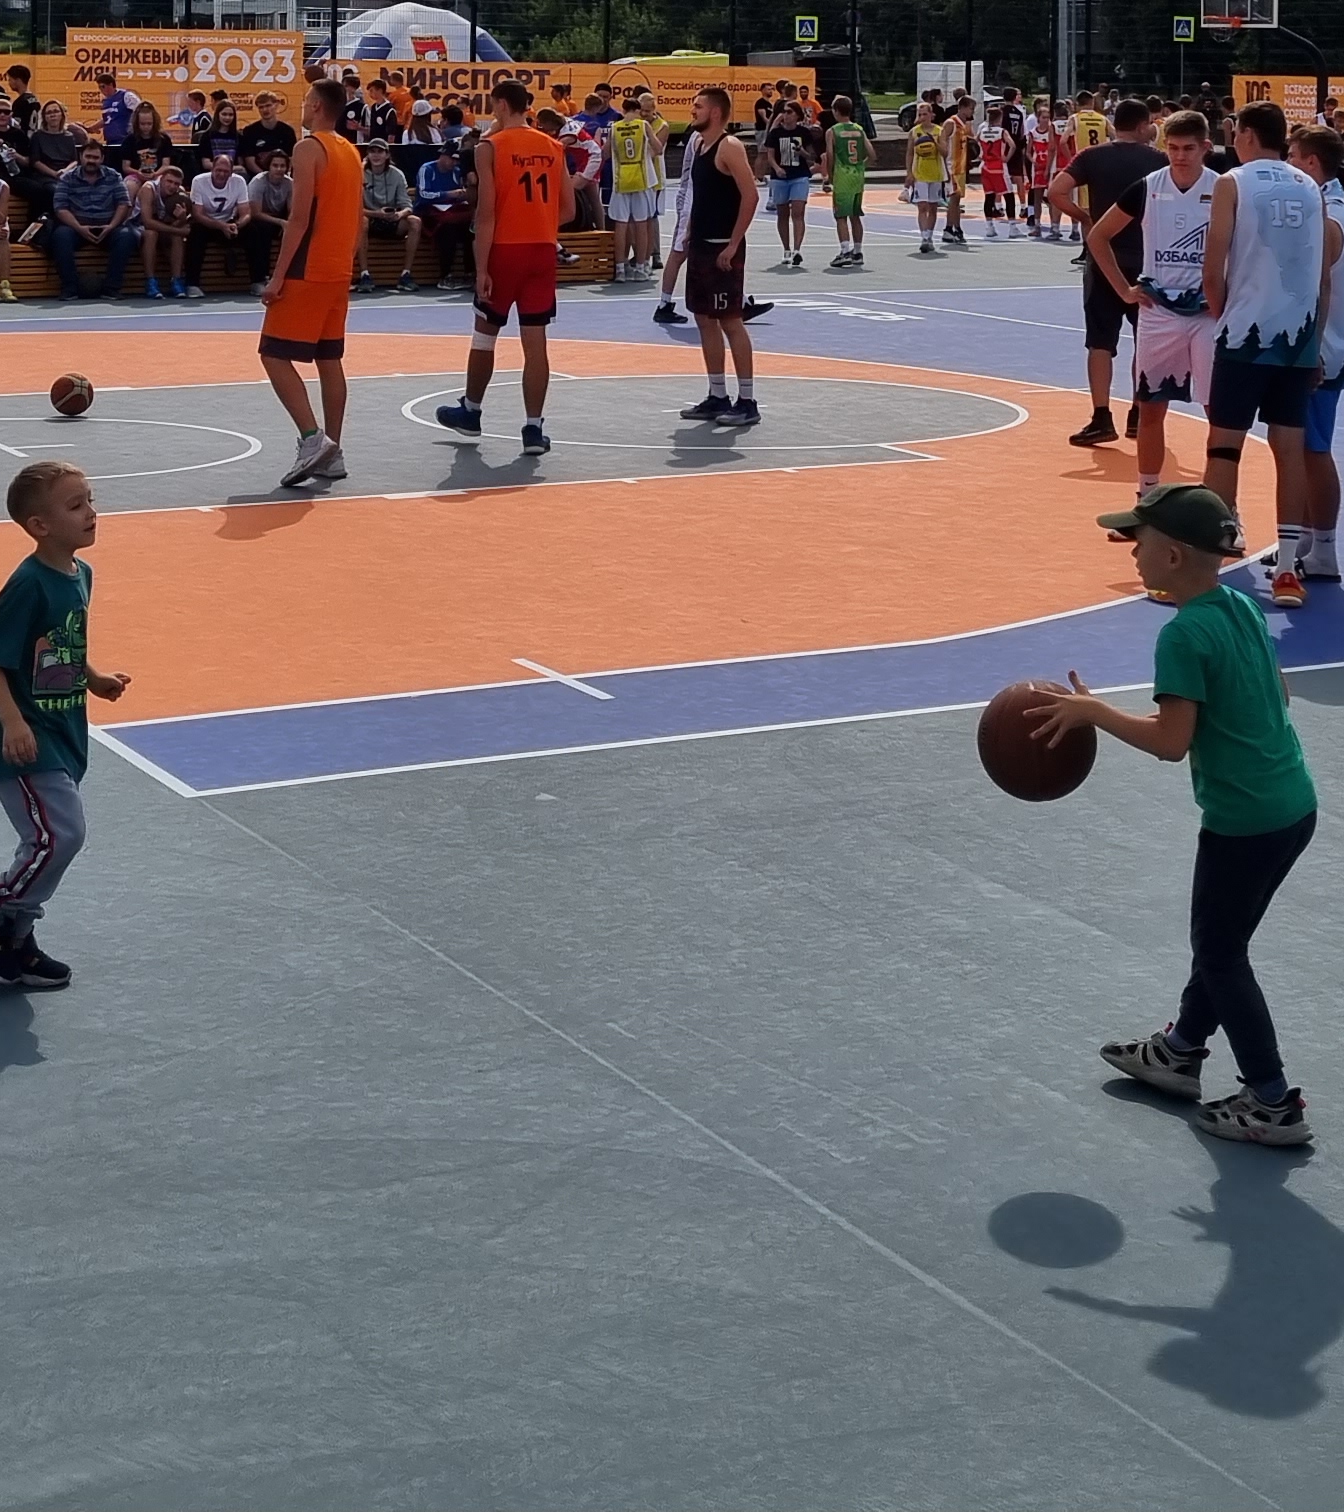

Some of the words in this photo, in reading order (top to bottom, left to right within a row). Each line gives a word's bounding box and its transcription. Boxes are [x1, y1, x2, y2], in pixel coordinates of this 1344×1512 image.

[74, 45, 189, 65] ОРАНЖЕВЫЙ
[192, 47, 296, 83] 2023
[611, 86, 635, 99] РФ
[511, 154, 555, 168] КузГТУ
[847, 140, 858, 164] 5
[518, 171, 548, 204] 11
[212, 197, 227, 213] 7
[1270, 198, 1304, 229] 15
[1174, 213, 1187, 229] 5
[713, 292, 729, 310] 15
